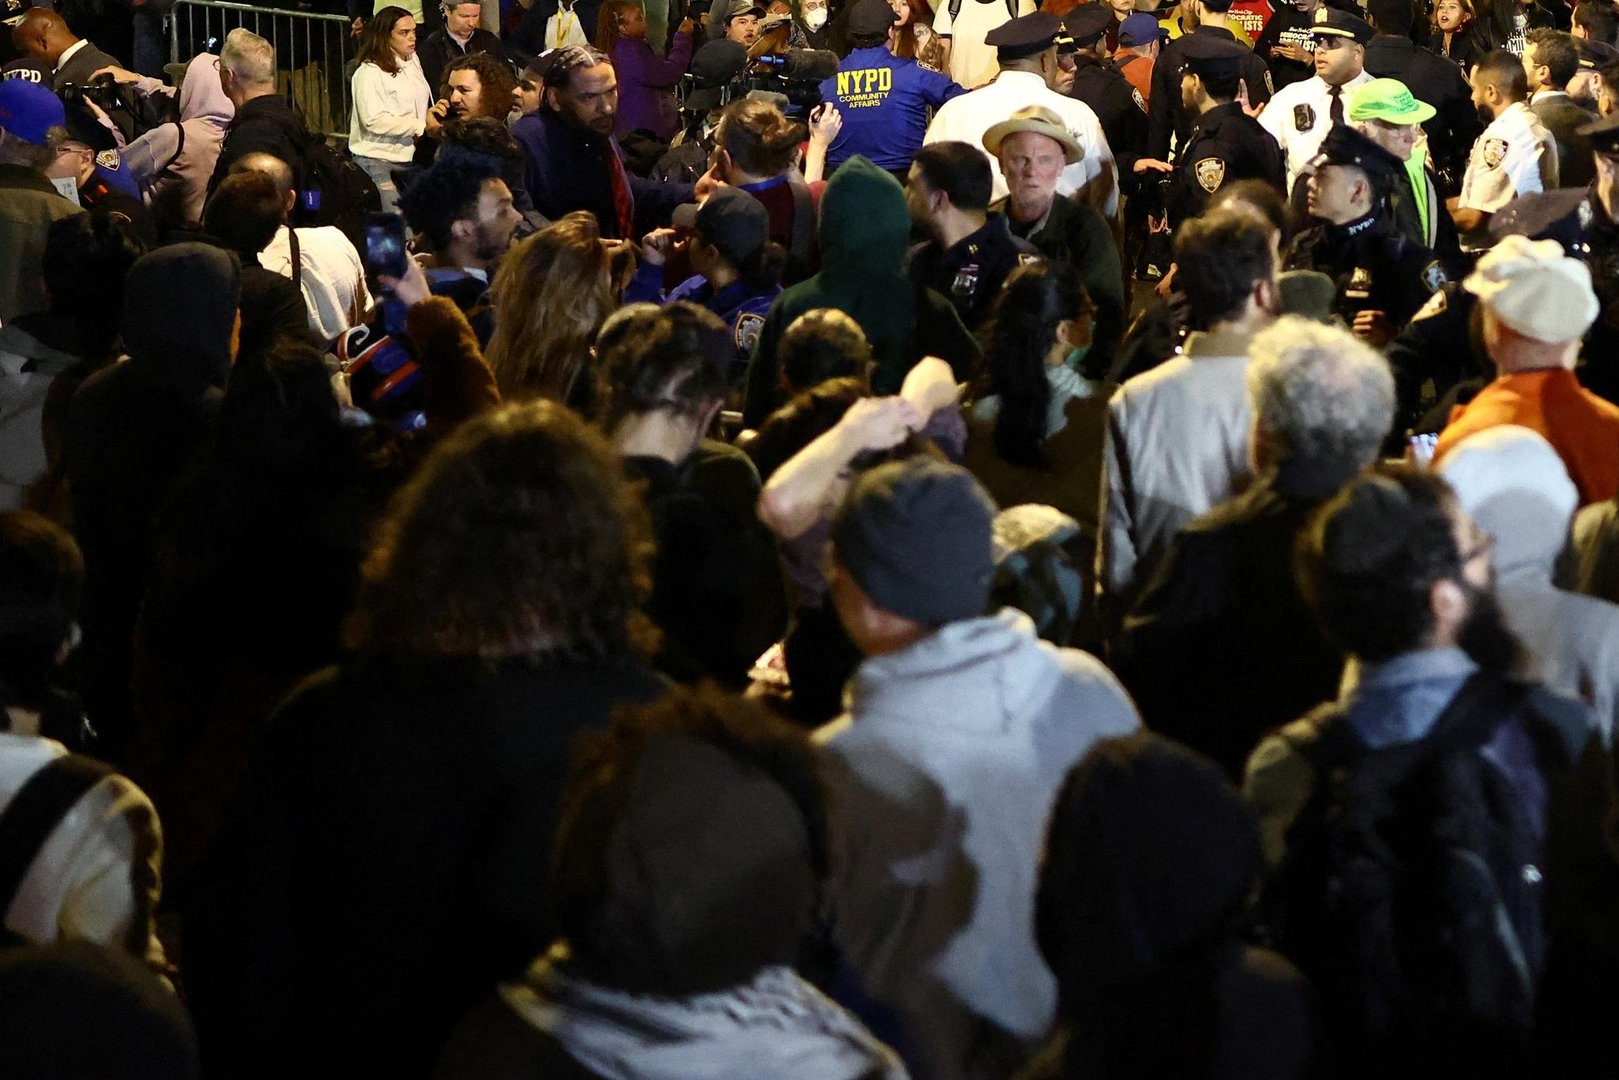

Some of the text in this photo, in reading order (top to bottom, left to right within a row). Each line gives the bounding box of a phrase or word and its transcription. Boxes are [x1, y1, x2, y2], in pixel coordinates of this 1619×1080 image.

[836, 67, 893, 95] NYPD
[839, 91, 889, 103] COMMUNITY
[849, 100, 881, 109] AFFAIRS
